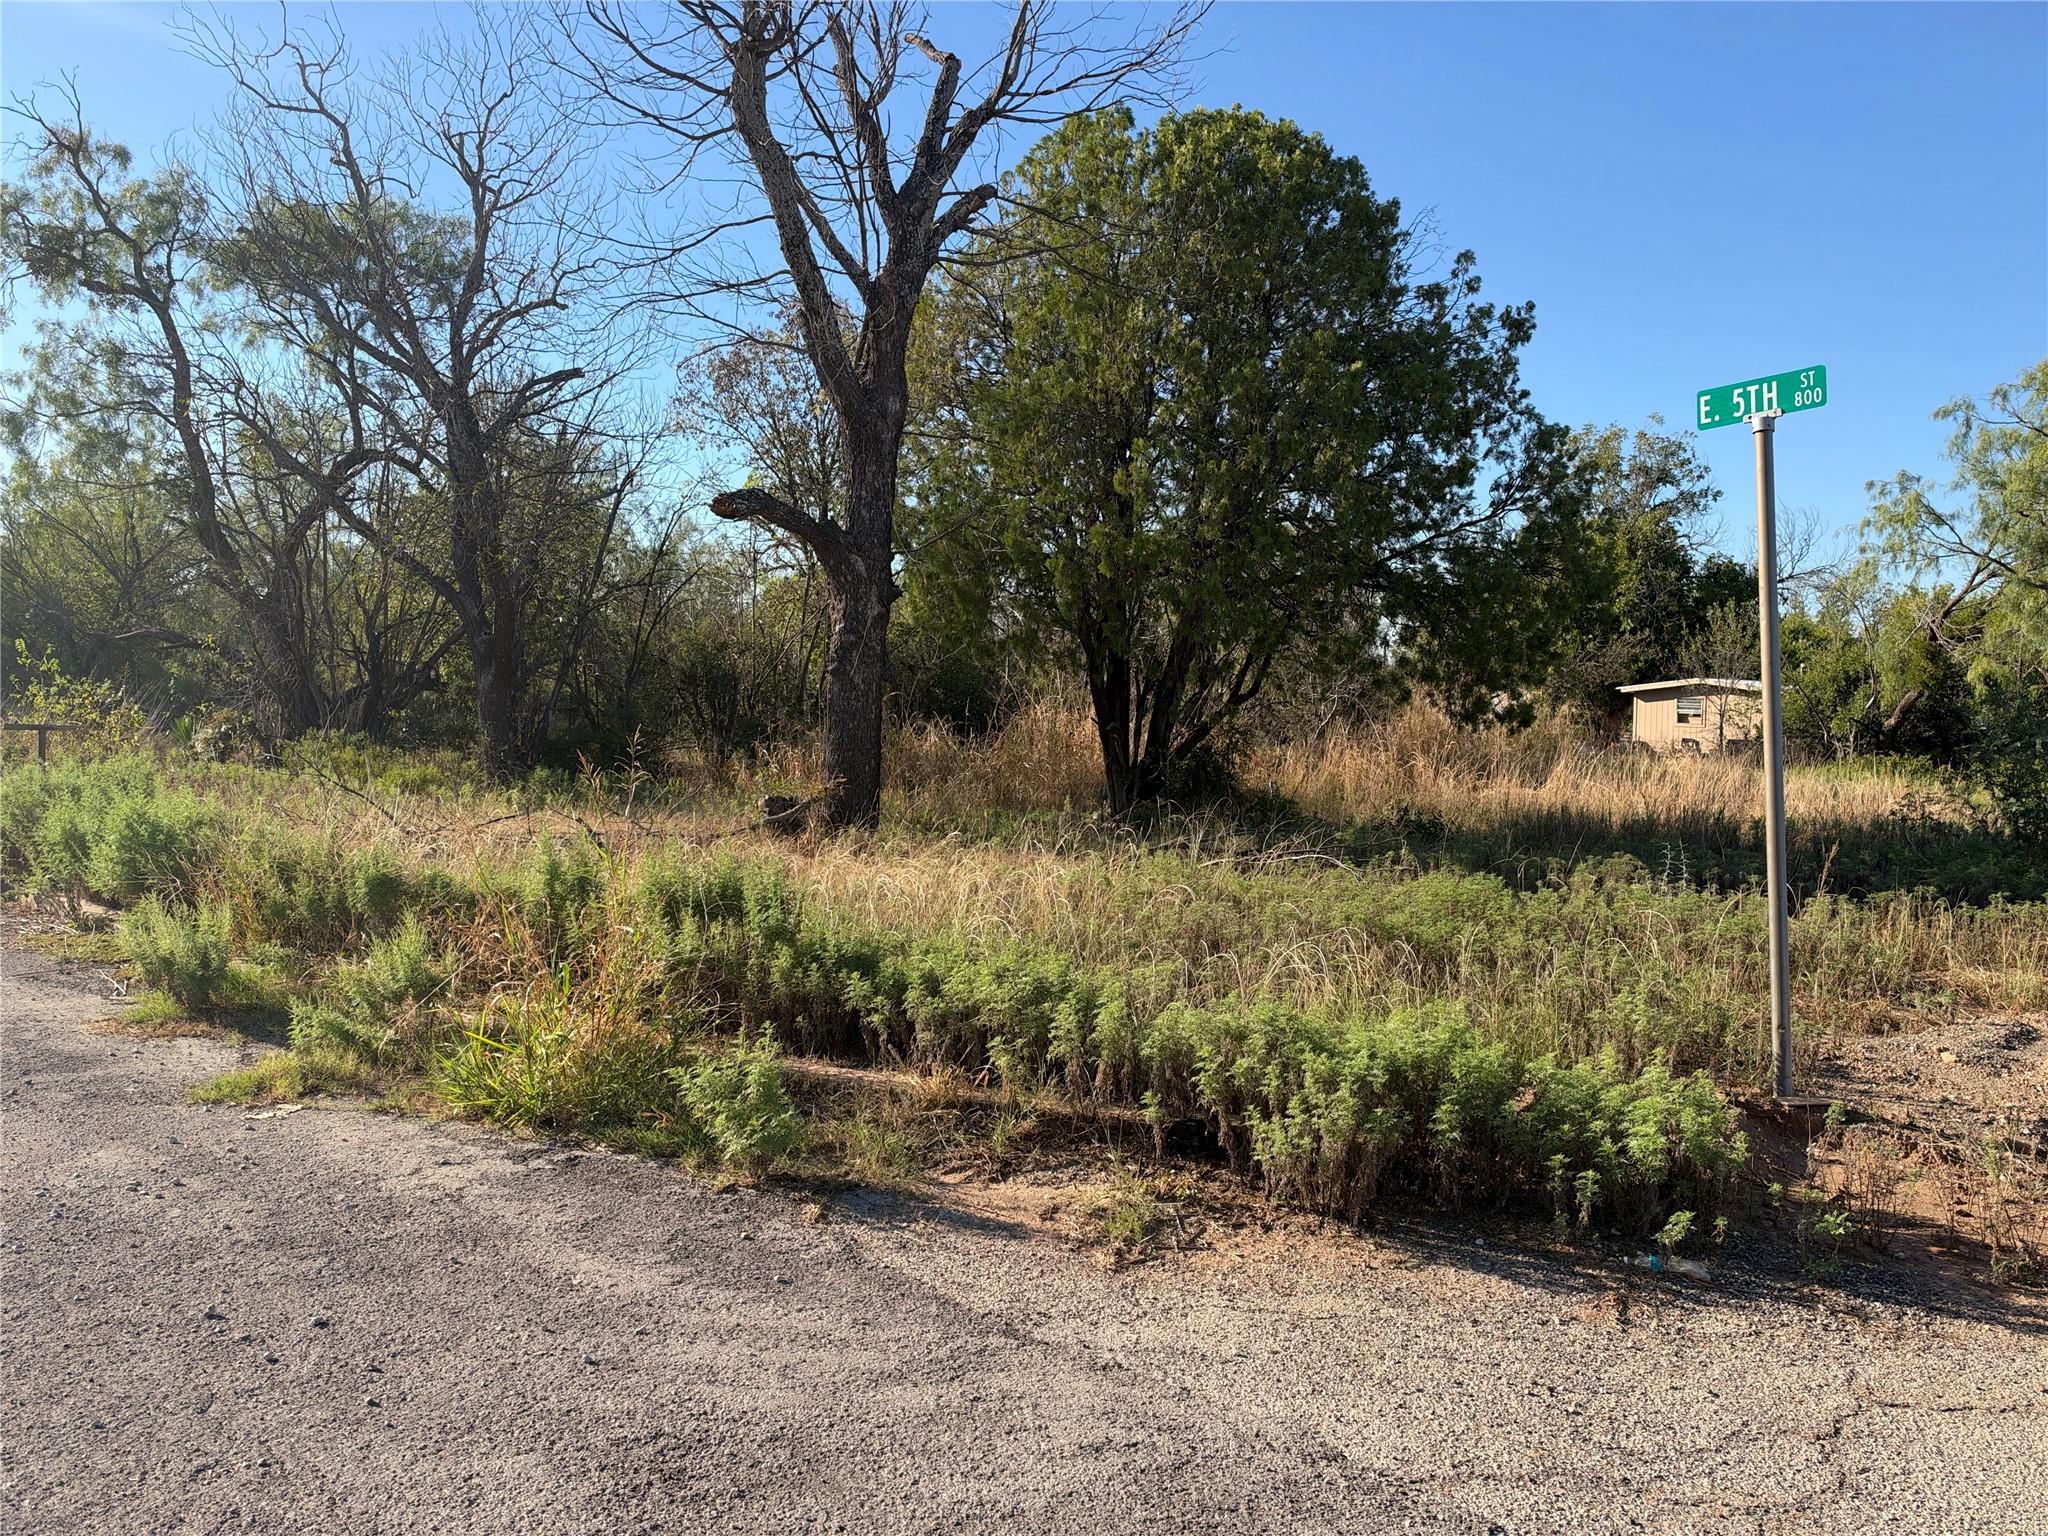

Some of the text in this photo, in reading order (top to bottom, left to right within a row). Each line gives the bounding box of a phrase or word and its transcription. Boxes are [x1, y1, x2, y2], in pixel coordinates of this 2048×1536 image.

[1800, 370, 1816, 388] ST
[1700, 380, 1778, 424] E. 5TH
[1794, 387, 1823, 407] 800
